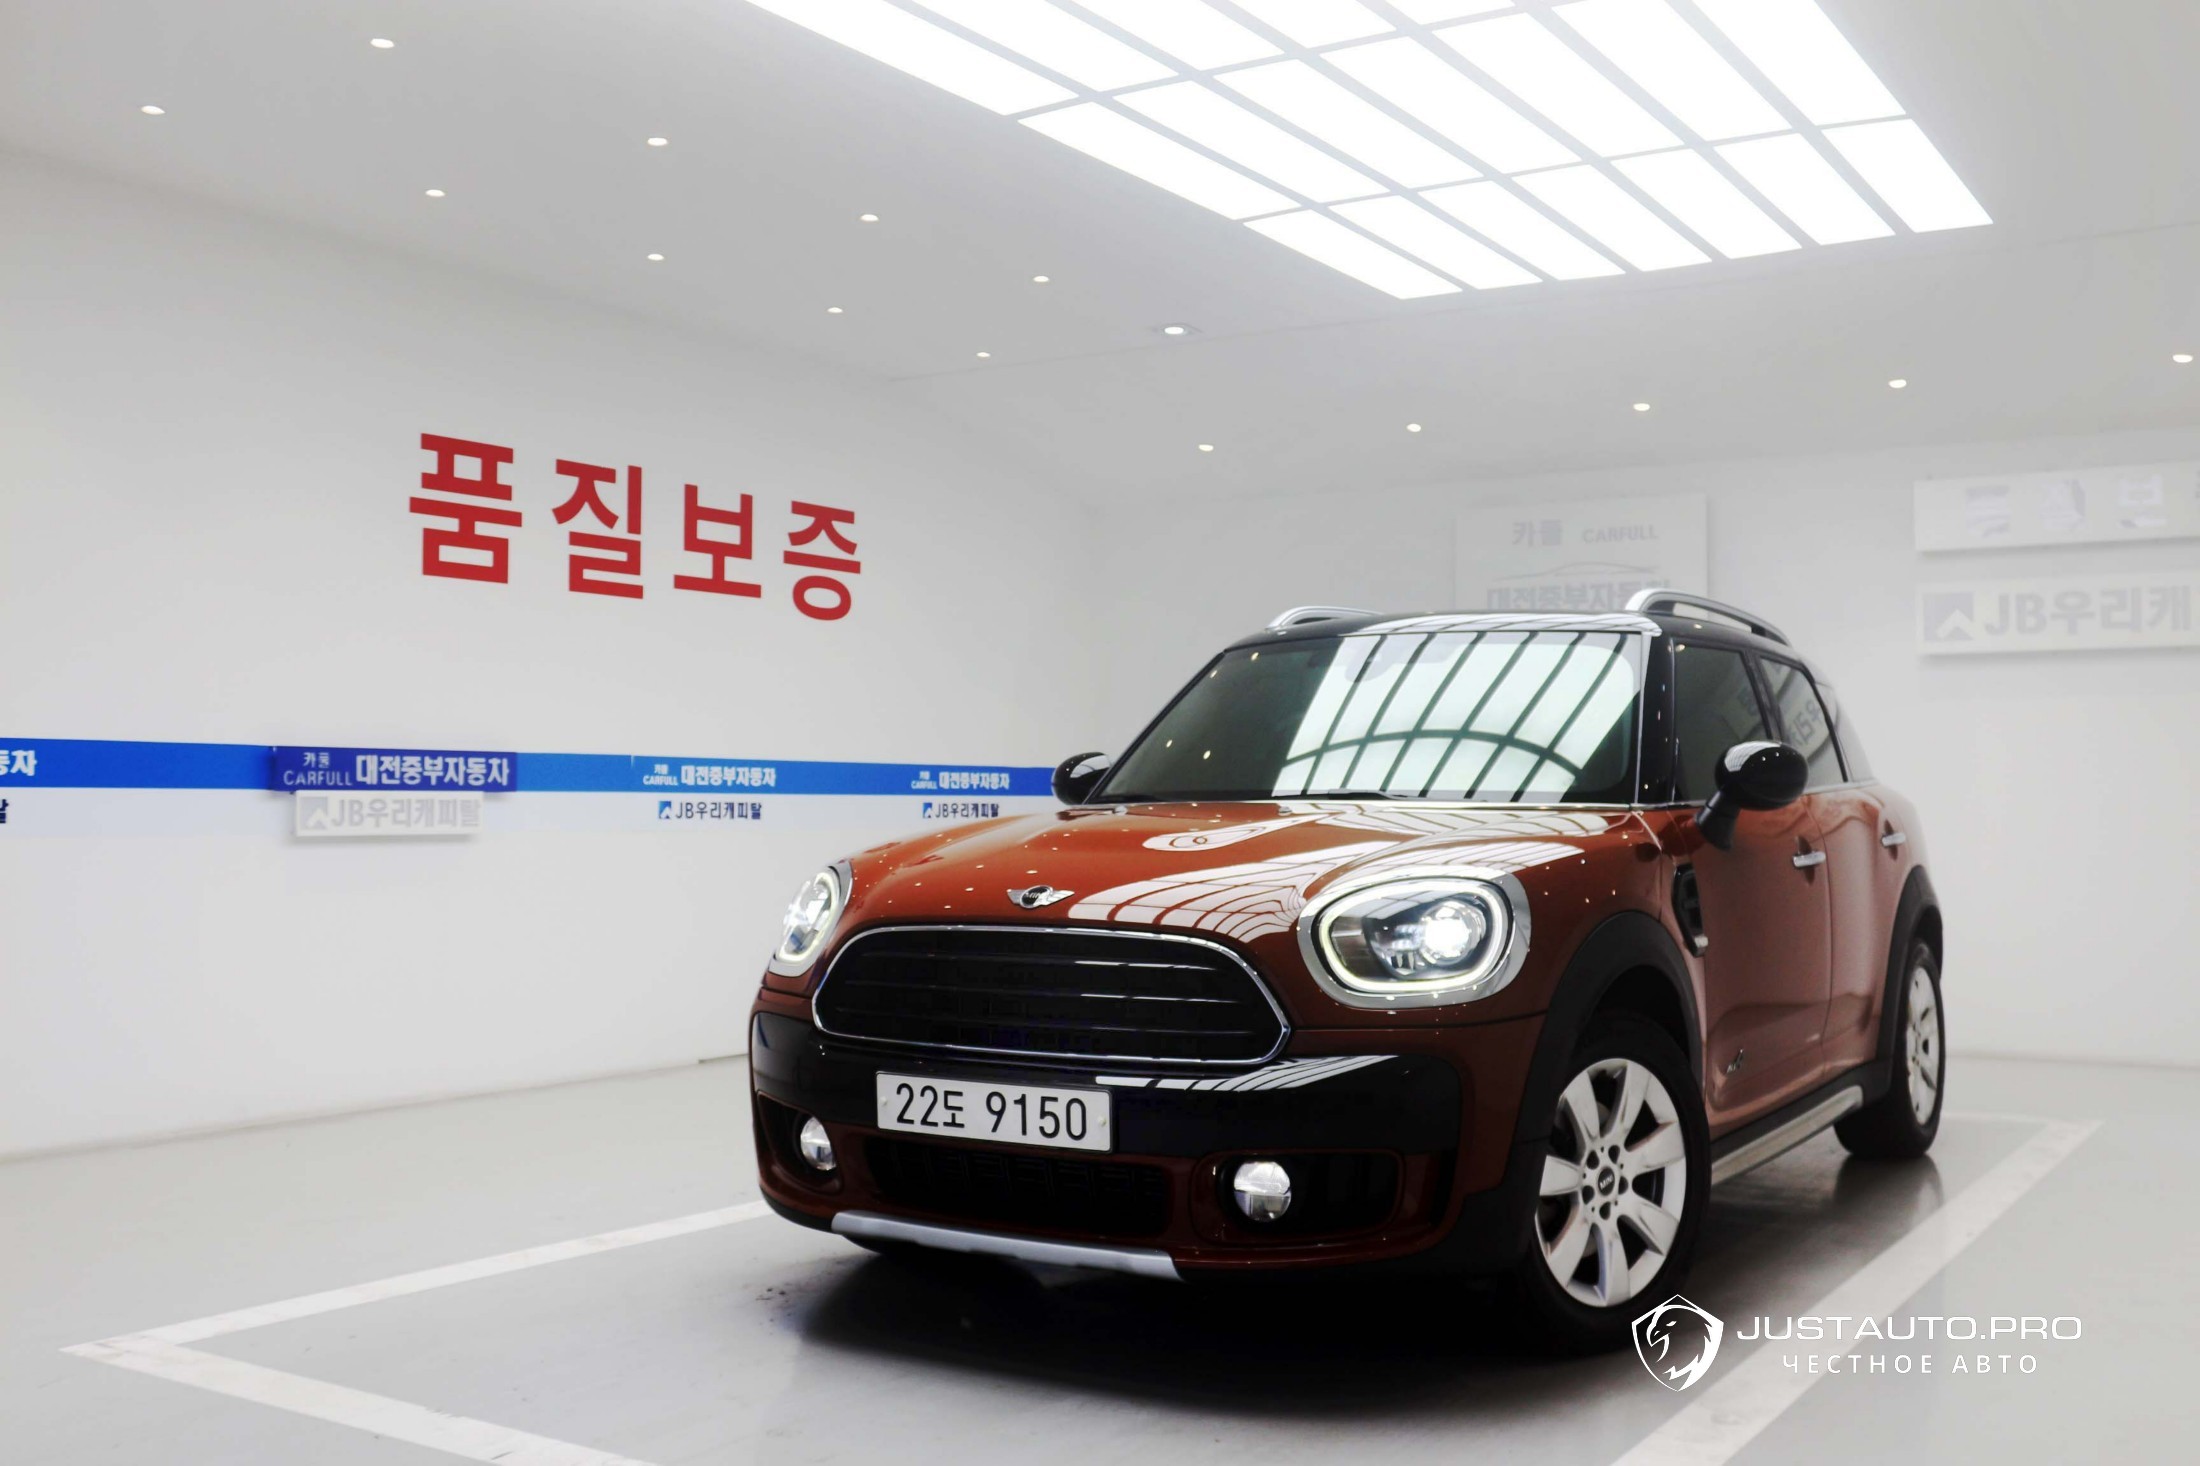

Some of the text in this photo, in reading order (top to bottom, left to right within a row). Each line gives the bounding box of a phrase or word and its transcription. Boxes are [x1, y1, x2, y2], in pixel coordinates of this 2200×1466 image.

[409, 433, 861, 621] 품질보증
[1582, 525, 1658, 544] CARFULL
[283, 771, 352, 787] CARFULL
[356, 754, 510, 786] 대전중부자동차
[681, 764, 776, 787] 대전중부자동차
[332, 798, 481, 829] JB우리캐피탈
[675, 801, 762, 820] JB우리캐피탈
[896, 1083, 1087, 1140] 22도 9150
